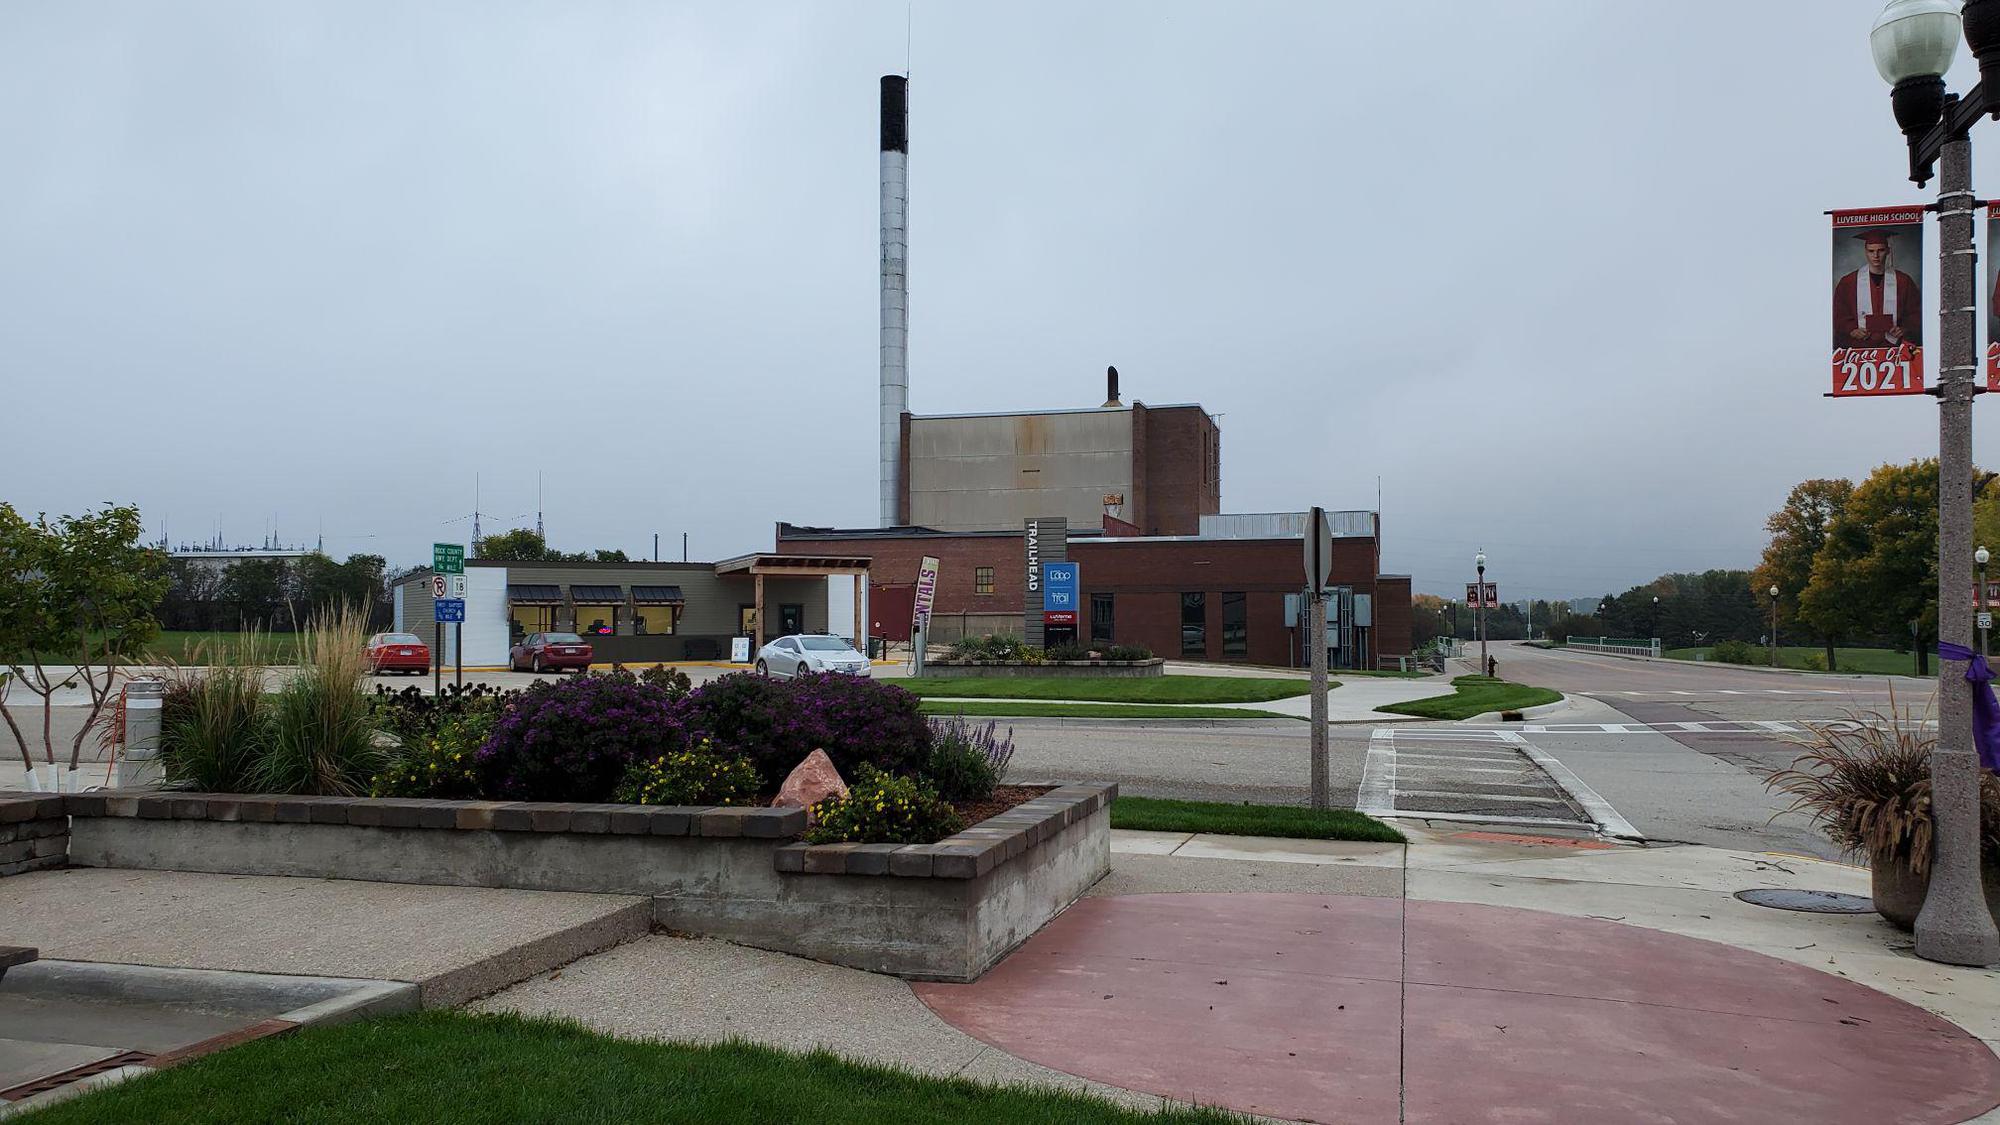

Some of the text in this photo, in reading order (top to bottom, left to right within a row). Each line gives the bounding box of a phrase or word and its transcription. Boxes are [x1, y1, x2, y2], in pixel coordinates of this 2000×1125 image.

[1836, 212, 1920, 224] LUVERNE HIGH SCHOOL
[1832, 344, 1905, 366] Class of
[1841, 361, 1911, 391] 2021
[1028, 521, 1038, 591] TRAILHEAD
